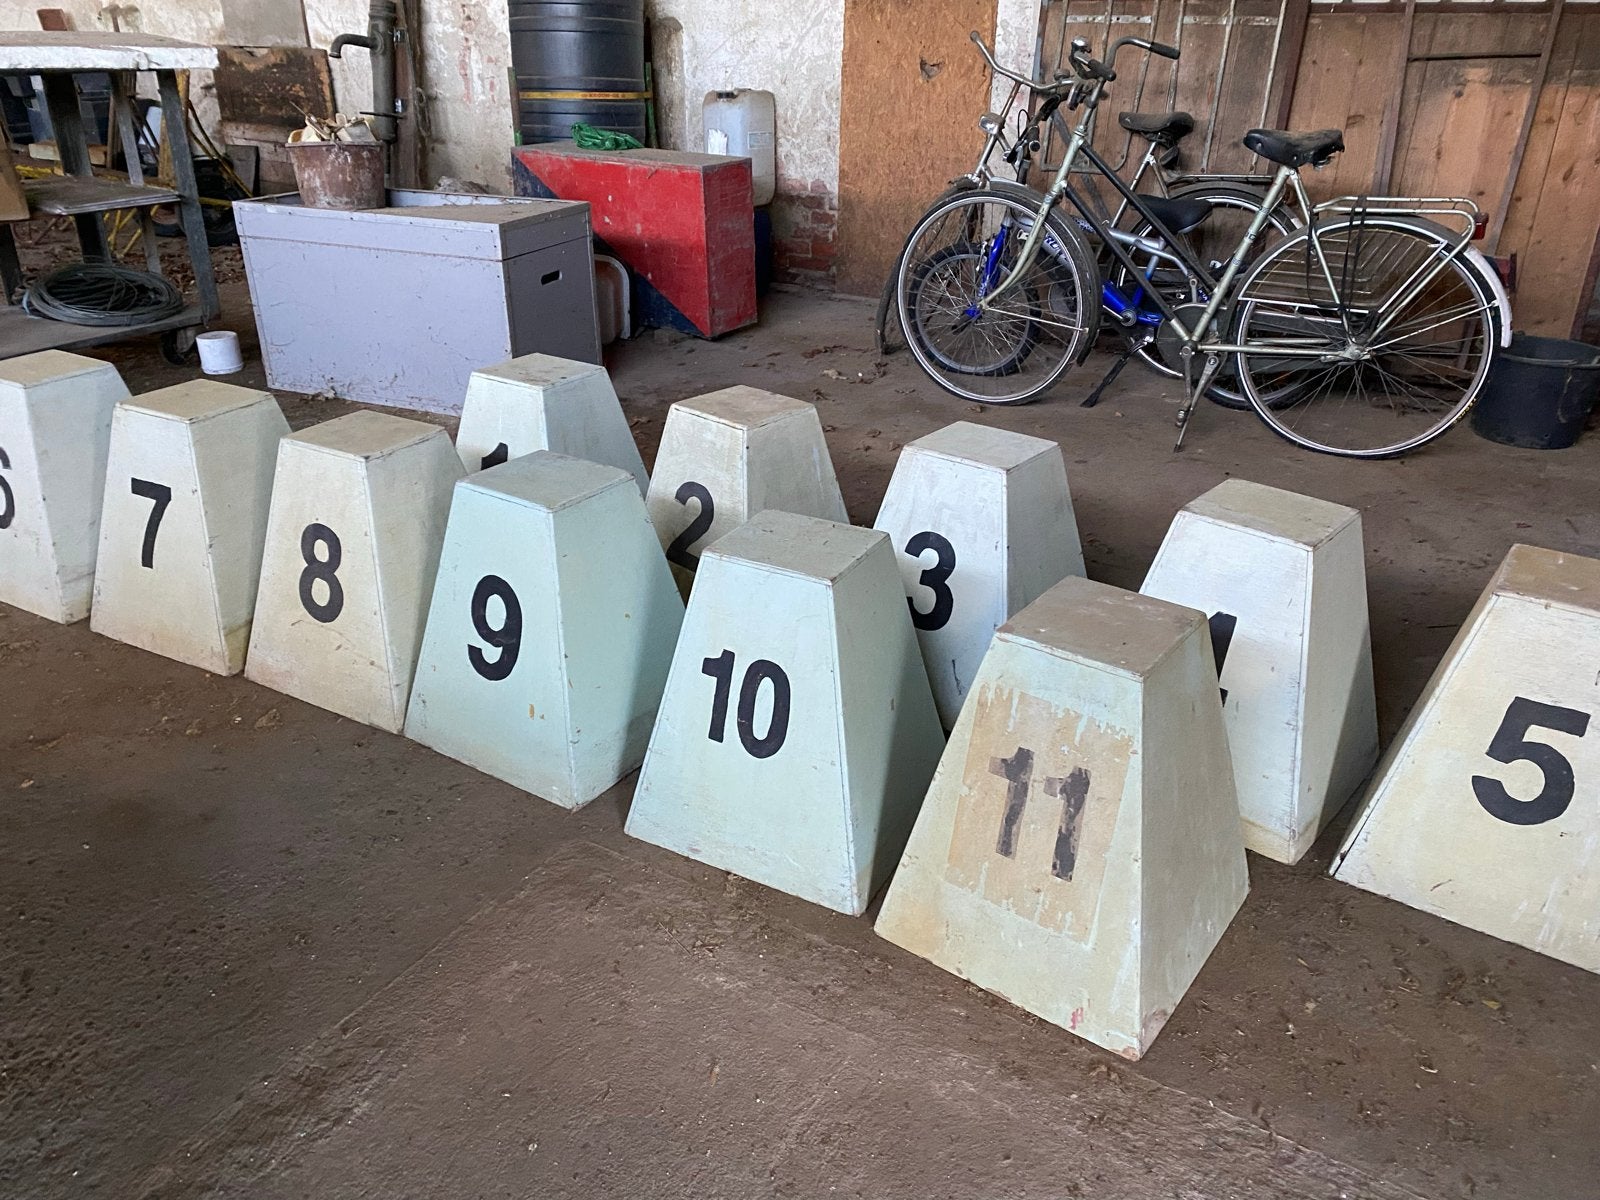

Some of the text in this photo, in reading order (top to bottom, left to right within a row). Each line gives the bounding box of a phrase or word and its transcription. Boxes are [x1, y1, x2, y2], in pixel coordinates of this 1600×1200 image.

[130, 477, 172, 569] 7
[298, 522, 344, 623] 8
[665, 481, 715, 573] 2
[467, 574, 523, 681] 9
[904, 531, 956, 632] 3
[701, 648, 791, 759] 10
[1471, 696, 1591, 826] 5
[988, 746, 1092, 882] 11
